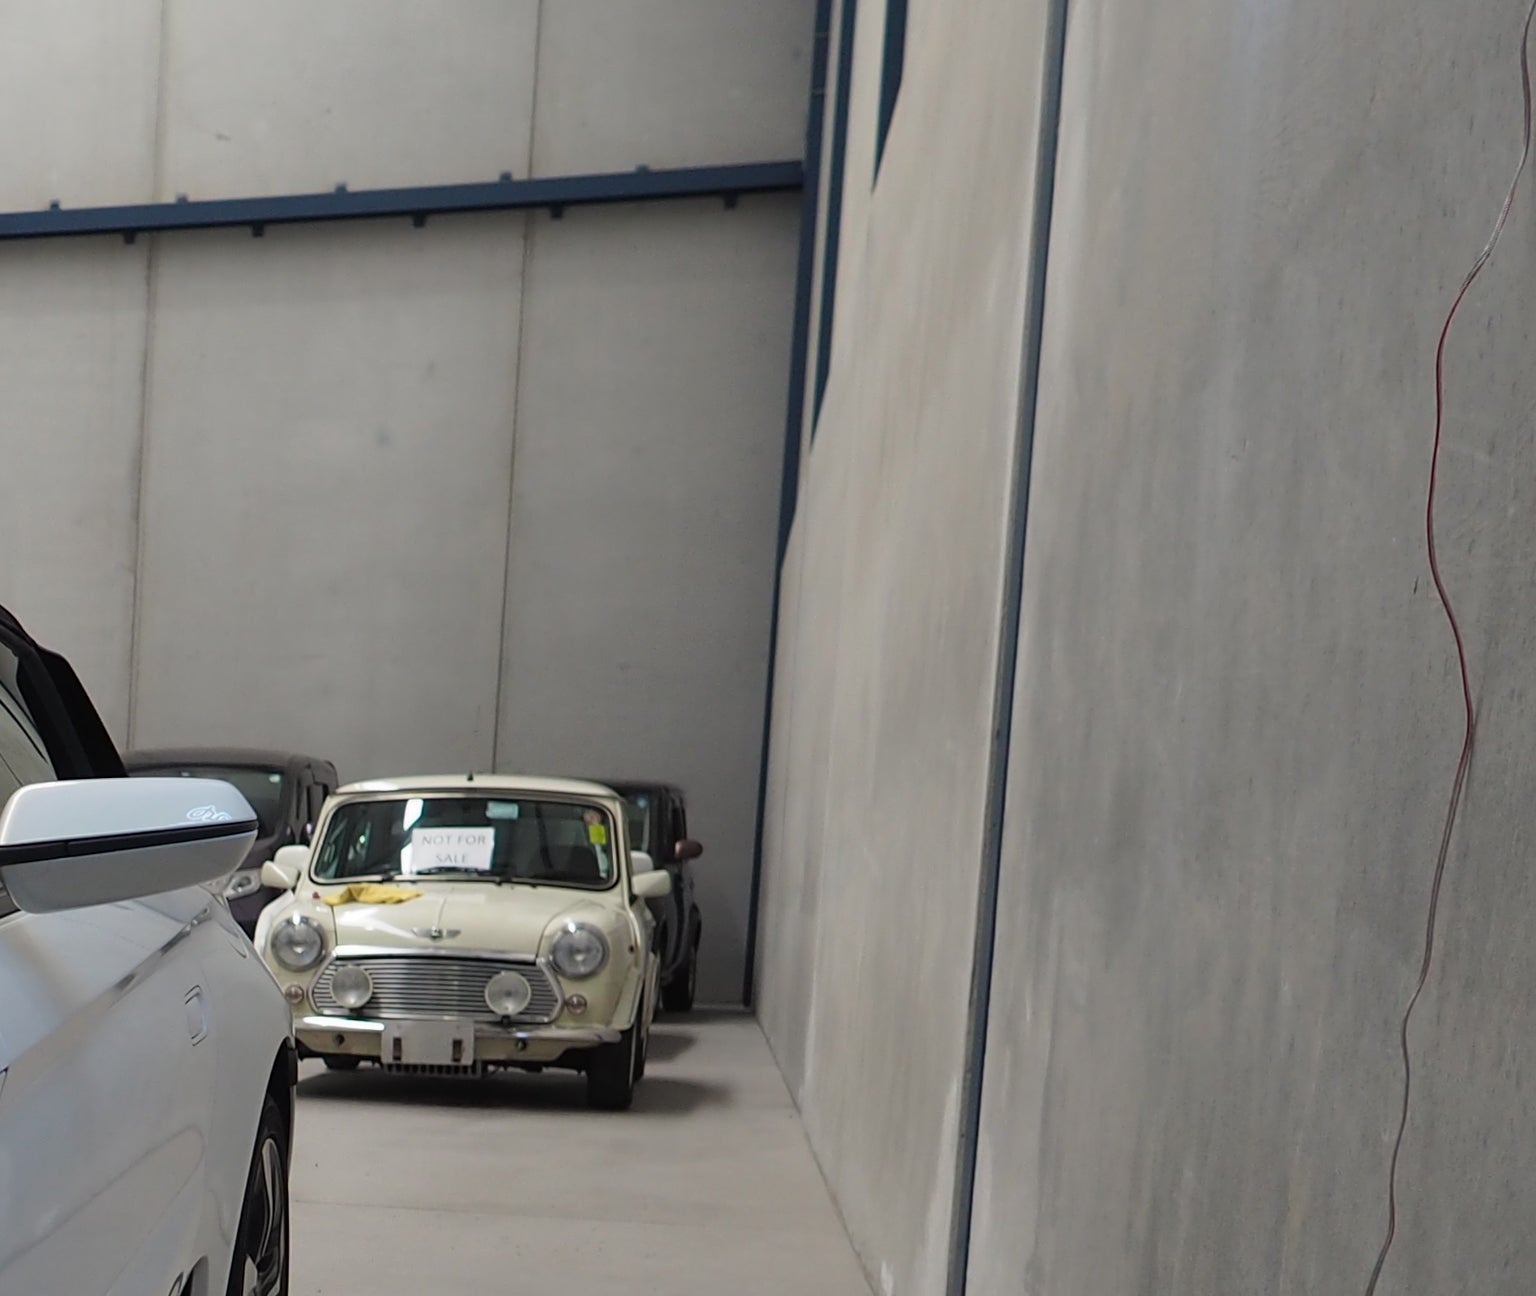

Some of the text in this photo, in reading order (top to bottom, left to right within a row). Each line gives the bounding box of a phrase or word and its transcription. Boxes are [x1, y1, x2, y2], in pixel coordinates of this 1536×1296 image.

[422, 834, 487, 846] NOT FOR
[436, 853, 467, 864] SALE
